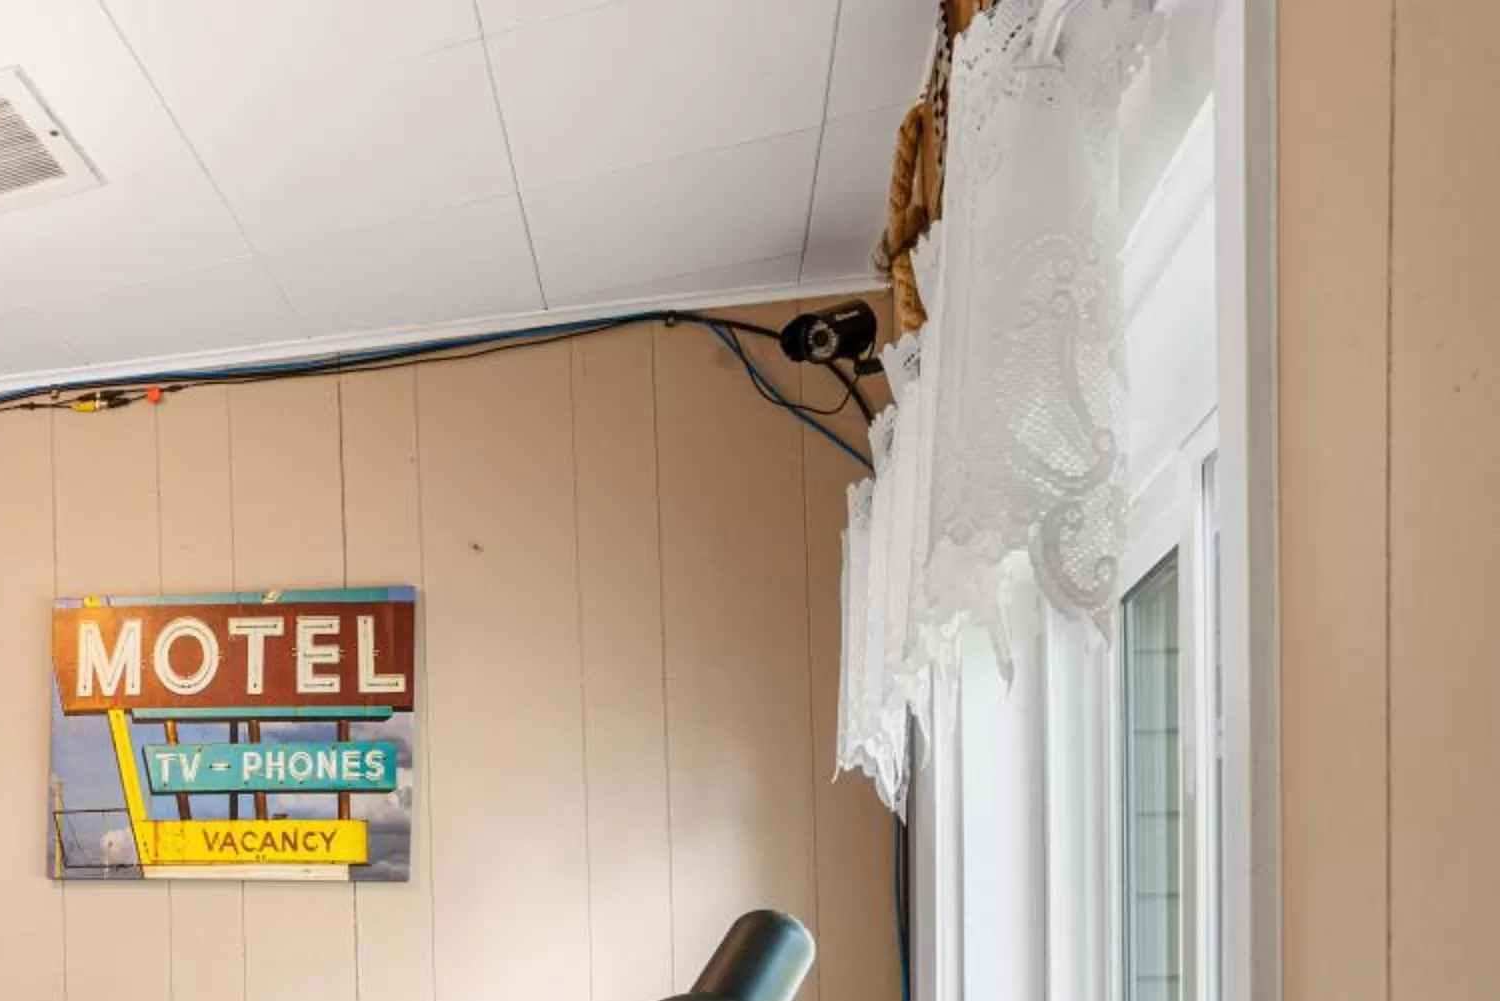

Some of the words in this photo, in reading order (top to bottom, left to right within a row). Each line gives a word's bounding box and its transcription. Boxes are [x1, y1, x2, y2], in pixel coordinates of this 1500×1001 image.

[77, 615, 406, 698] MOTEL
[155, 752, 202, 783] TV
[242, 750, 386, 783] PHONES
[203, 827, 340, 855] VACANCY
